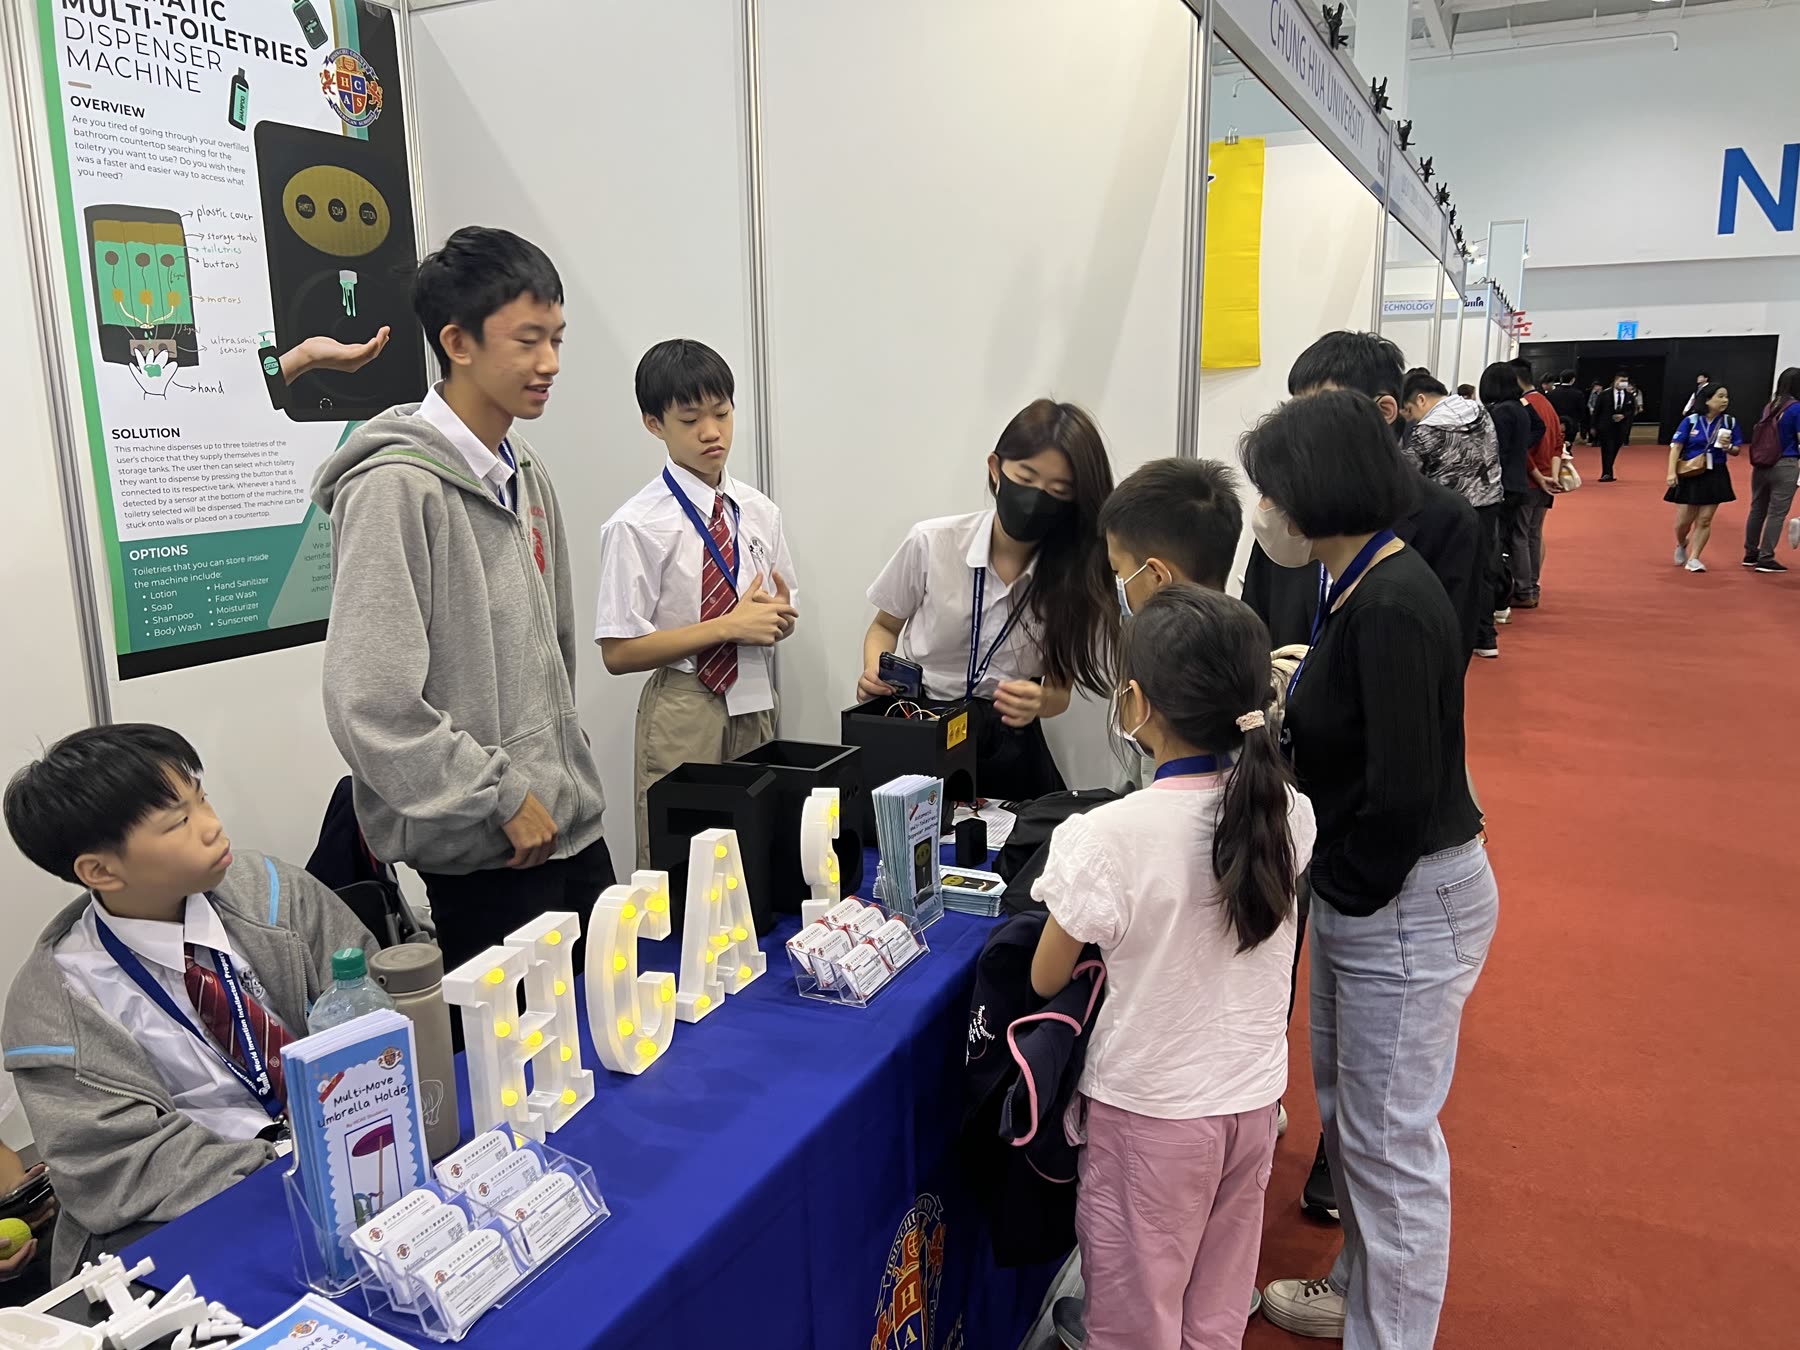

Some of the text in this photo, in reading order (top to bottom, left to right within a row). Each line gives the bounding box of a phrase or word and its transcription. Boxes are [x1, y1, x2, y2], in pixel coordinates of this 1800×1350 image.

[62, 0, 308, 67] MULTI-TOILETRIES
[65, 16, 222, 72] DISPENSER
[66, 45, 201, 93] MACHINE
[1270, 0, 1365, 149] CHUNG HUA UNIVERSITY
[341, 77, 361, 90] H C
[70, 96, 145, 118] OVERVIEW
[344, 95, 362, 106] A S
[72, 115, 88, 124] Are
[108, 122, 128, 131] tired
[139, 128, 163, 139] going
[165, 131, 198, 144] through
[74, 128, 232, 161] bathroom countertop searching for the
[75, 142, 106, 154] toiletry
[108, 147, 124, 156] you
[125, 150, 147, 159] want
[180, 157, 192, 166] Do
[227, 165, 246, 175] there
[97, 171, 123, 180] need?
[103, 157, 127, 168] faster
[147, 166, 171, 174] easier
[173, 170, 189, 179] way
[201, 174, 226, 182] access
[226, 177, 244, 186] what
[1716, 143, 1800, 235] N
[197, 205, 253, 222] plastic cover
[207, 233, 257, 244] storage tanks
[202, 246, 241, 254] toiletries
[204, 259, 239, 269] buttons
[1384, 303, 1434, 311] ECHNOLOGY
[210, 337, 256, 345] ultrasonic
[220, 346, 247, 354] sensor
[198, 382, 224, 394] hand
[112, 428, 180, 440] SOLUTION
[211, 473, 240, 481] pressing
[121, 488, 161, 496] connected
[123, 498, 156, 508] detected
[152, 507, 182, 516] selected
[207, 503, 242, 512] dispensed.
[126, 521, 146, 529] stuck
[194, 515, 217, 524] placed
[234, 511, 270, 519] countertop.
[129, 544, 189, 561] OPTIONS
[132, 566, 172, 576] Toiletries
[173, 563, 191, 571] that
[192, 562, 208, 571] you
[226, 557, 246, 565] store
[247, 553, 269, 562] inside
[134, 571, 222, 589] the machine include:
[214, 578, 269, 591] Hand Sanitizer
[150, 590, 177, 600] Lotion
[215, 590, 257, 603] Face Wash
[151, 603, 173, 612] Soap
[216, 602, 259, 614] Moisturizer
[153, 613, 194, 624] Shampoo
[217, 615, 258, 626] Sunscreen
[154, 622, 202, 637] Body Wash
[218, 951, 262, 1072] World Invention Intellectual Propert
[334, 1076, 393, 1108] Multi-Move
[375, 1083, 412, 1103] Holder
[901, 1281, 917, 1312] H
[904, 1324, 918, 1350] A
